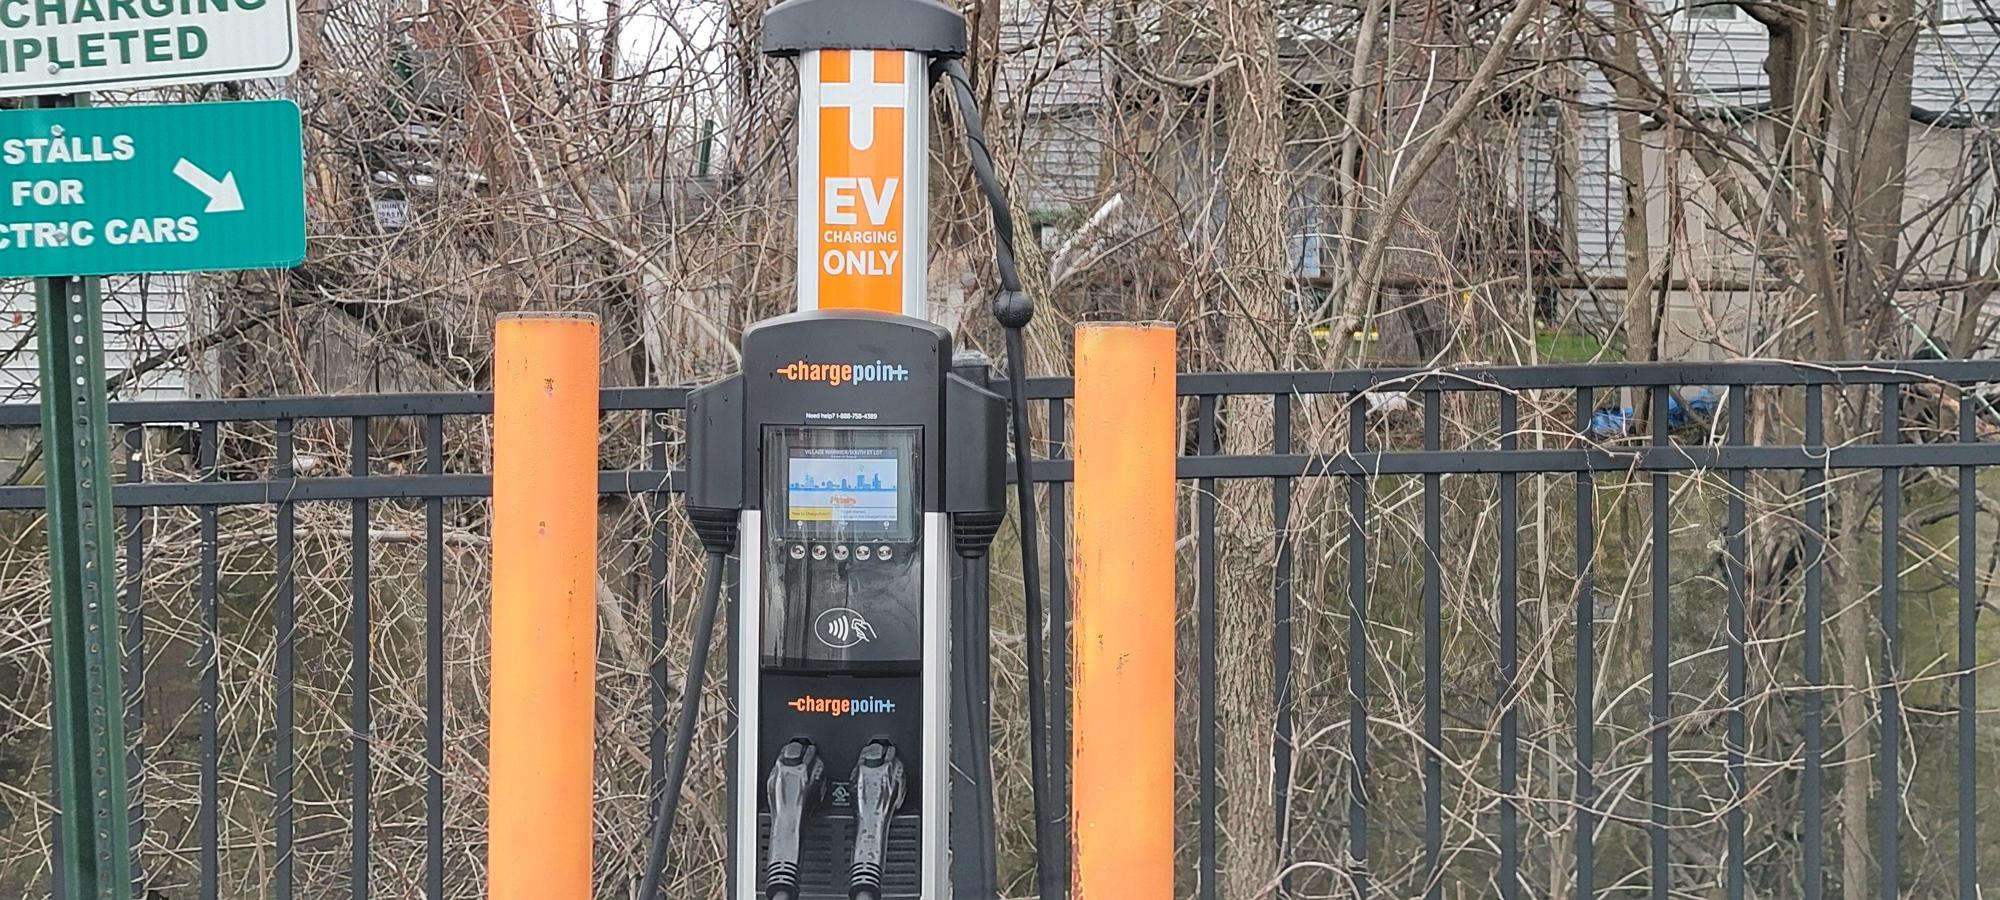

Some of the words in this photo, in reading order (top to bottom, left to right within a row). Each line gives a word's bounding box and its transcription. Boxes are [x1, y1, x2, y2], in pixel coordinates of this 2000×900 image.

[3, 135, 136, 165] STALLS
[12, 179, 85, 206] FOR
[824, 177, 899, 226] EV
[105, 216, 199, 244] CARS
[823, 230, 897, 244] CHARGING
[823, 249, 899, 276] ONLY
[777, 360, 909, 386] chargepoint
[788, 696, 896, 716] chargepoint
